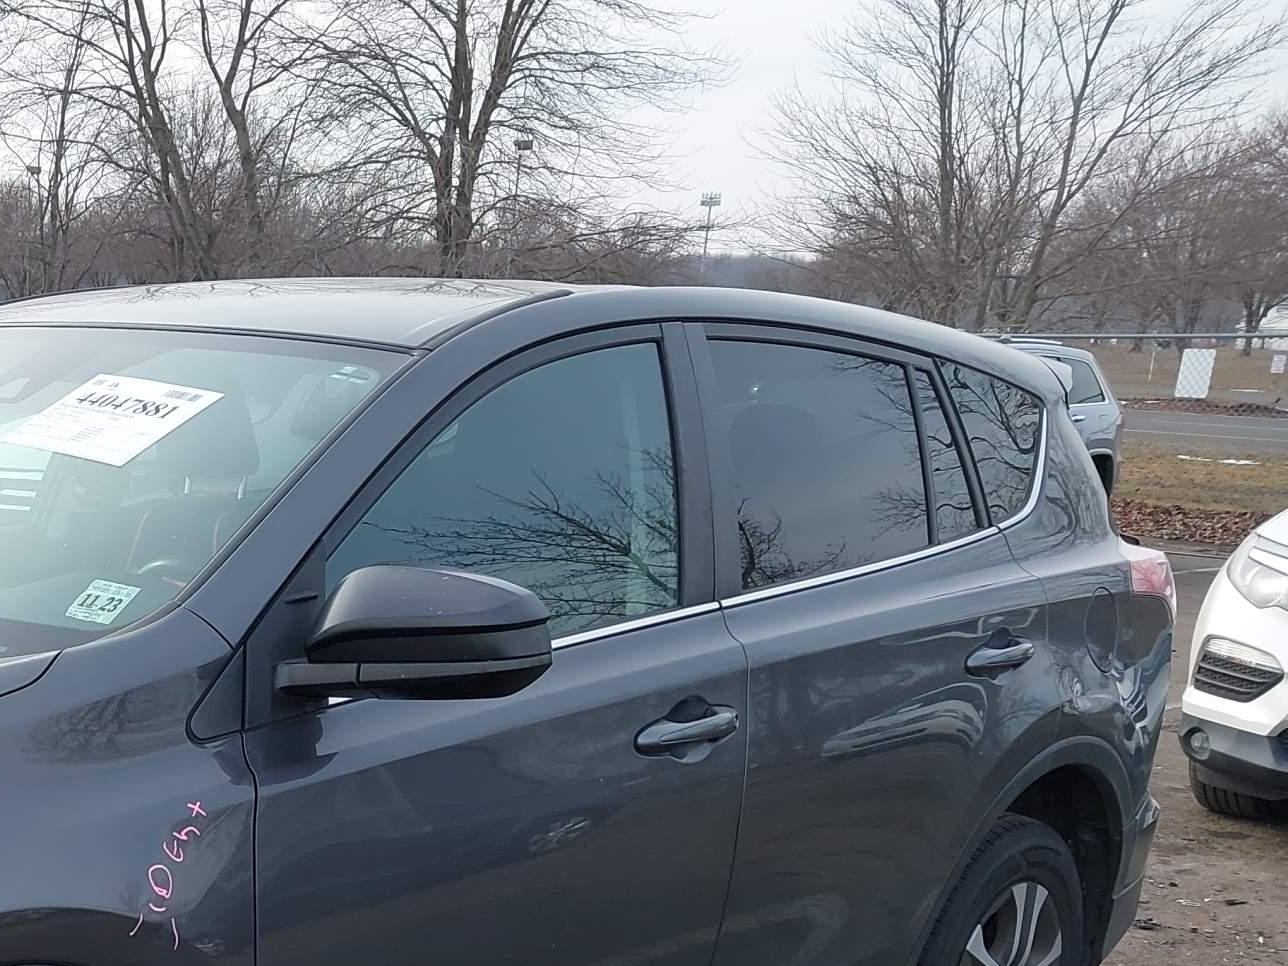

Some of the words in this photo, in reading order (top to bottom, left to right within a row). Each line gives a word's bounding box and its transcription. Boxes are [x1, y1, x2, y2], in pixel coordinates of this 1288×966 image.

[76, 391, 180, 419] 44047881
[77, 593, 102, 609] 11
[98, 597, 124, 613] 23
